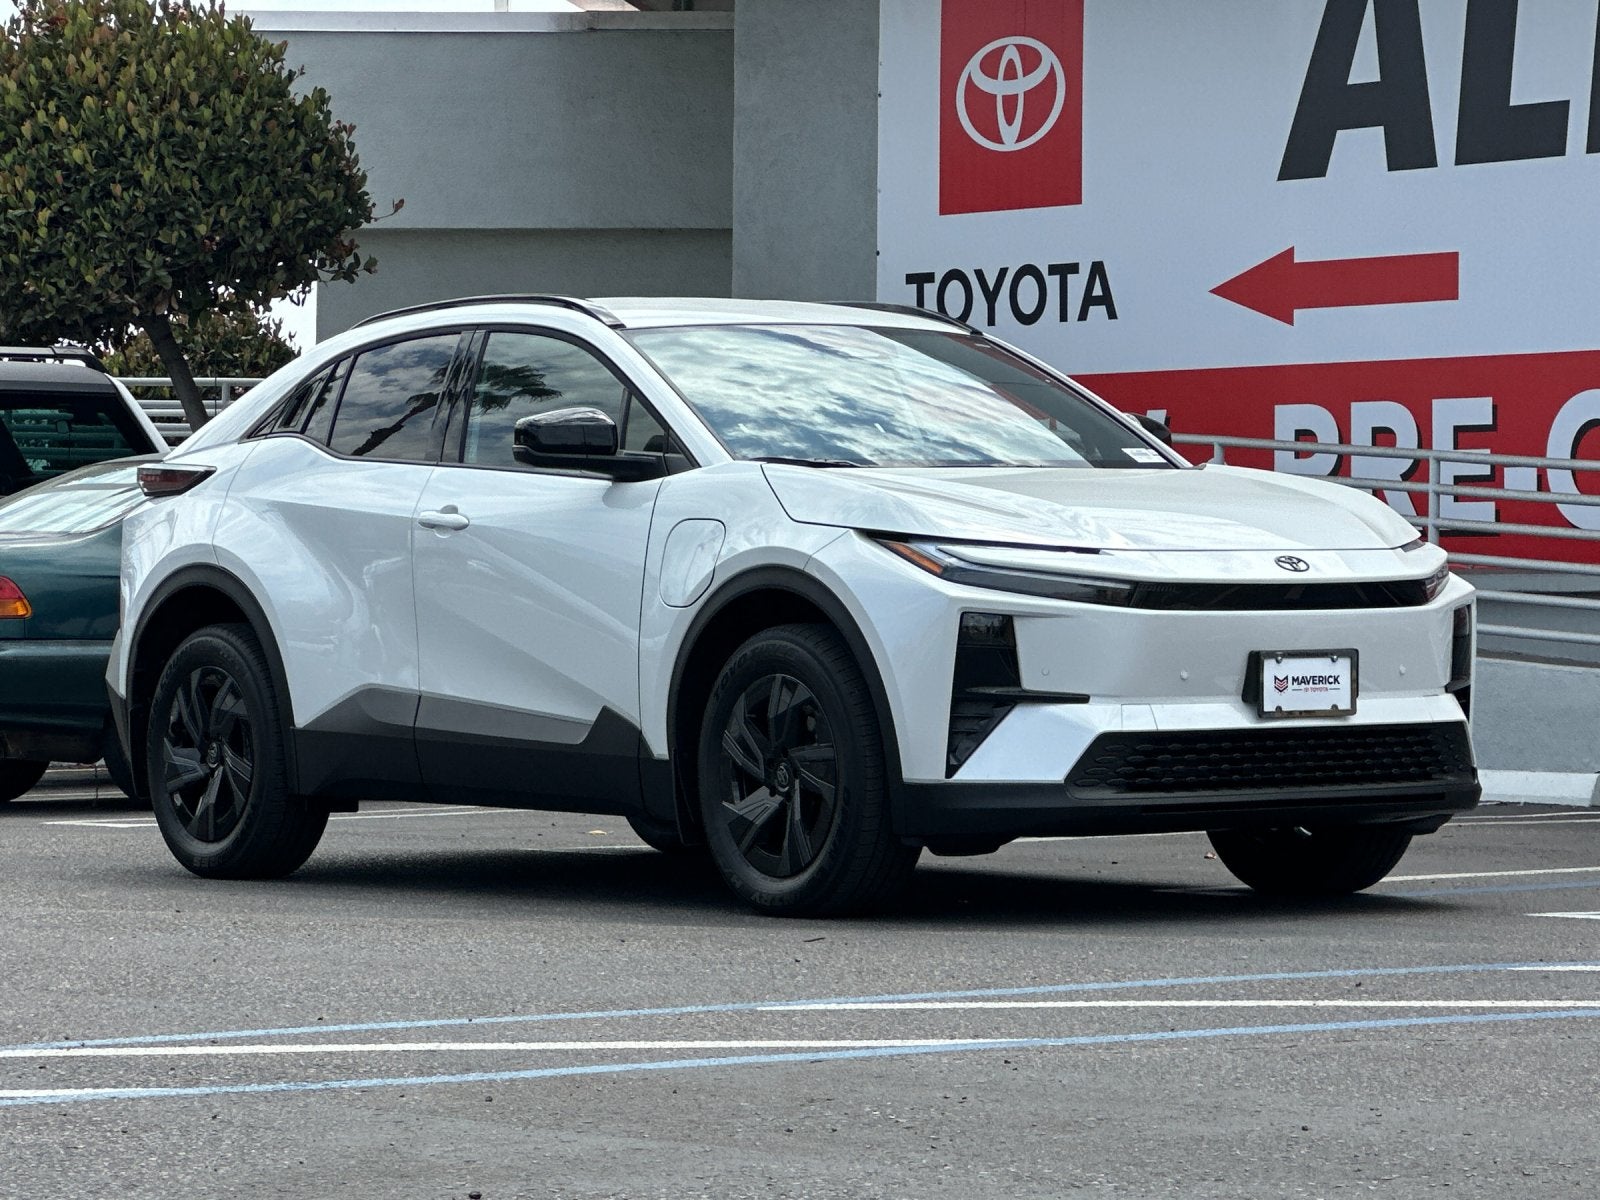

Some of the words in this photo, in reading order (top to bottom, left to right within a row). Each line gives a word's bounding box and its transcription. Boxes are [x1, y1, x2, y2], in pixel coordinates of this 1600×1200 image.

[1277, 0, 1600, 181] AL
[905, 260, 1118, 327] TOYOTA
[1291, 675, 1340, 686] MAVERICK
